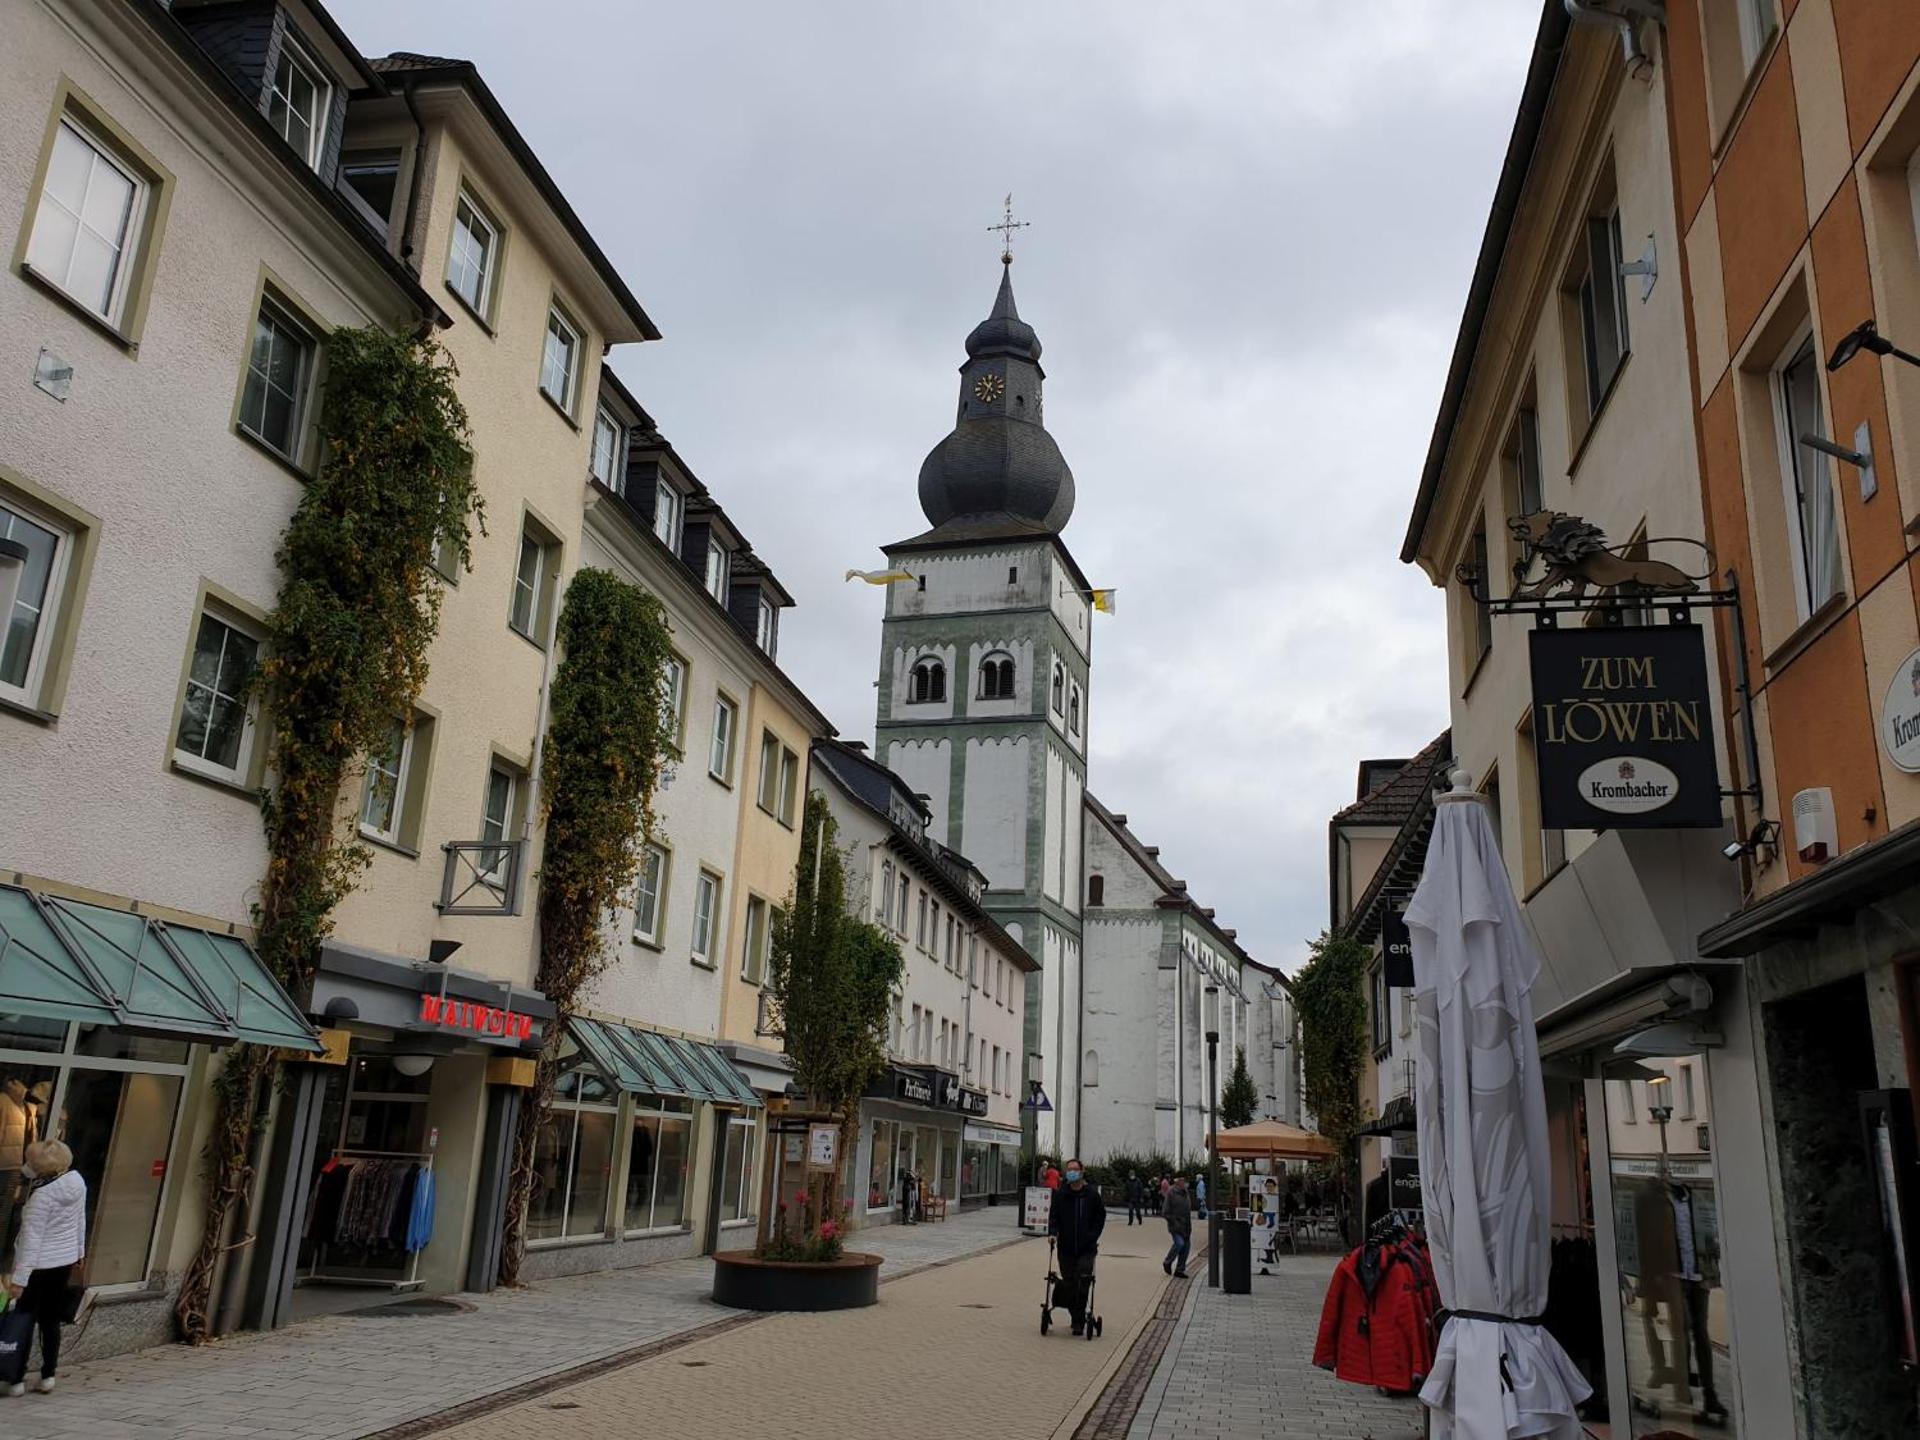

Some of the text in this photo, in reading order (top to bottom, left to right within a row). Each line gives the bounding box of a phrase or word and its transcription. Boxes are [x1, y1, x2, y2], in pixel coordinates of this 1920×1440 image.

[1581, 656, 1657, 690] ZUM
[1542, 697, 1701, 744] LÖWEN
[1591, 780, 1669, 798] Krombacher
[422, 993, 533, 1040] MAIWORM
